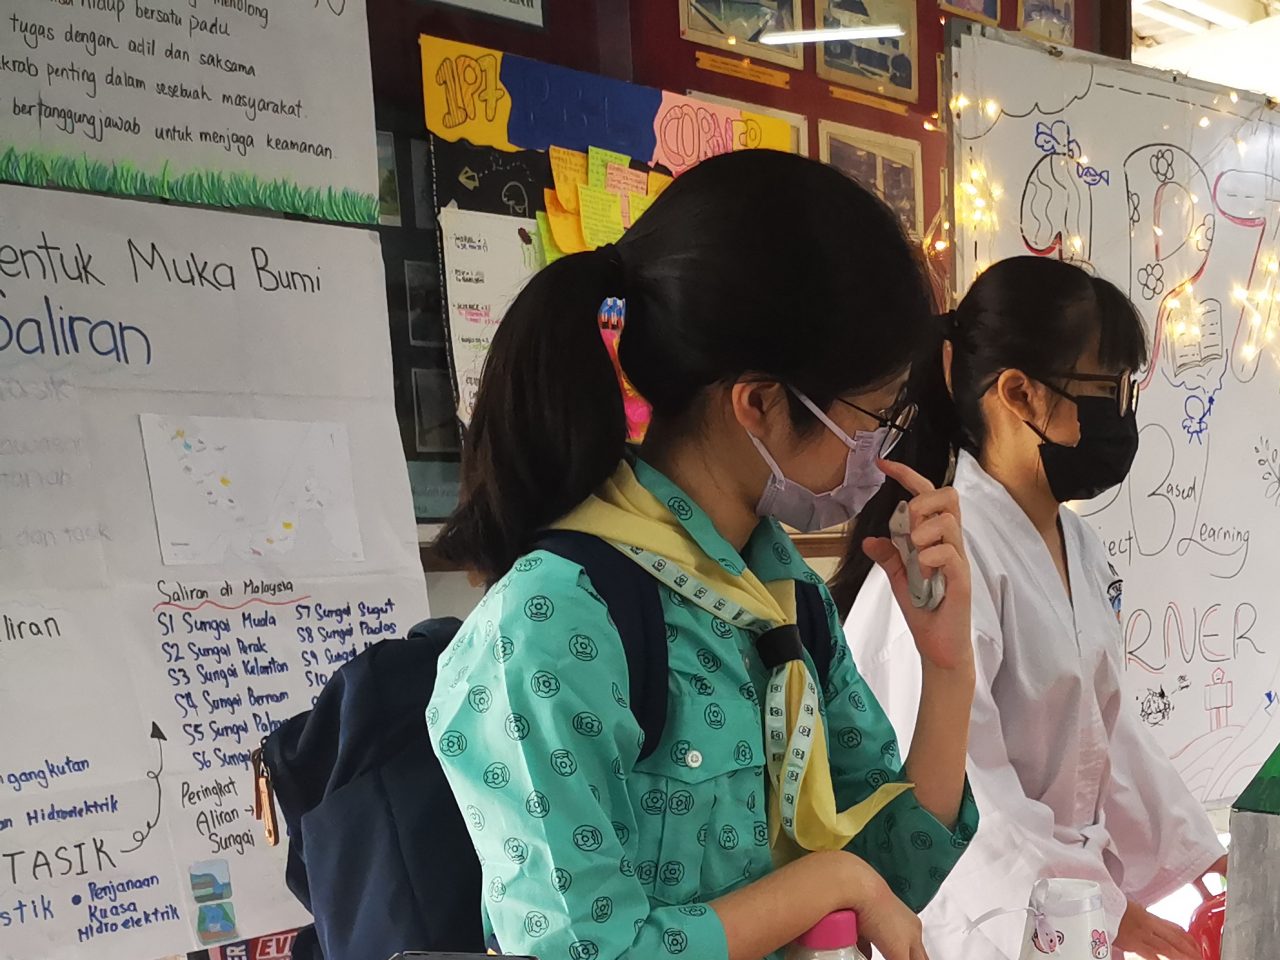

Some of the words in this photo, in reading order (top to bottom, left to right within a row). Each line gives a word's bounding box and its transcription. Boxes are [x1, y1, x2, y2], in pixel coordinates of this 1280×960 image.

[135, 0, 182, 26] bersatu
[189, 15, 230, 38] padu
[9, 13, 55, 49] tugas
[64, 24, 119, 56] dengan
[128, 38, 155, 56] adil
[164, 43, 190, 61] dan
[200, 53, 256, 76] saksama
[0, 55, 38, 77] krab
[47, 62, 96, 98] penting
[105, 67, 146, 90] dalam
[156, 83, 212, 101] sesebuah
[155, 126, 193, 142] untuk
[200, 128, 254, 156] menjaga
[0, 231, 106, 286] entuk
[127, 238, 236, 292] Muka
[251, 246, 321, 293] Bumi
[1128, 423, 1197, 557] Based
[1177, 431, 1250, 579] Learning
[220, 580, 233, 597] di
[243, 579, 294, 597] Malaysia
[158, 612, 174, 636] S1
[182, 612, 231, 640] Sungai
[241, 610, 277, 629] Muda
[296, 604, 310, 620] S7
[315, 601, 351, 624] Sungai
[358, 598, 395, 620] Sugut
[0, 616, 61, 642] liran
[297, 626, 314, 643] S8
[318, 623, 353, 645] Sungai
[1125, 602, 1266, 674] RNER
[161, 642, 185, 662] S2
[187, 642, 231, 664] Sungai
[302, 650, 318, 667] S9
[168, 668, 191, 686] S3
[196, 664, 239, 688] Sungai
[174, 691, 199, 718] S4
[203, 690, 242, 715] Sungai
[183, 723, 204, 746] S5
[209, 719, 249, 744] Sungai
[193, 750, 212, 771] S6
[181, 777, 238, 808] Peringkat
[196, 808, 240, 836] Aliran
[208, 830, 255, 855] Sungai
[2, 837, 117, 884] TASIK
[0, 895, 54, 926] stik
[88, 875, 160, 902] Penjanaan
[88, 902, 138, 924] Kuasa
